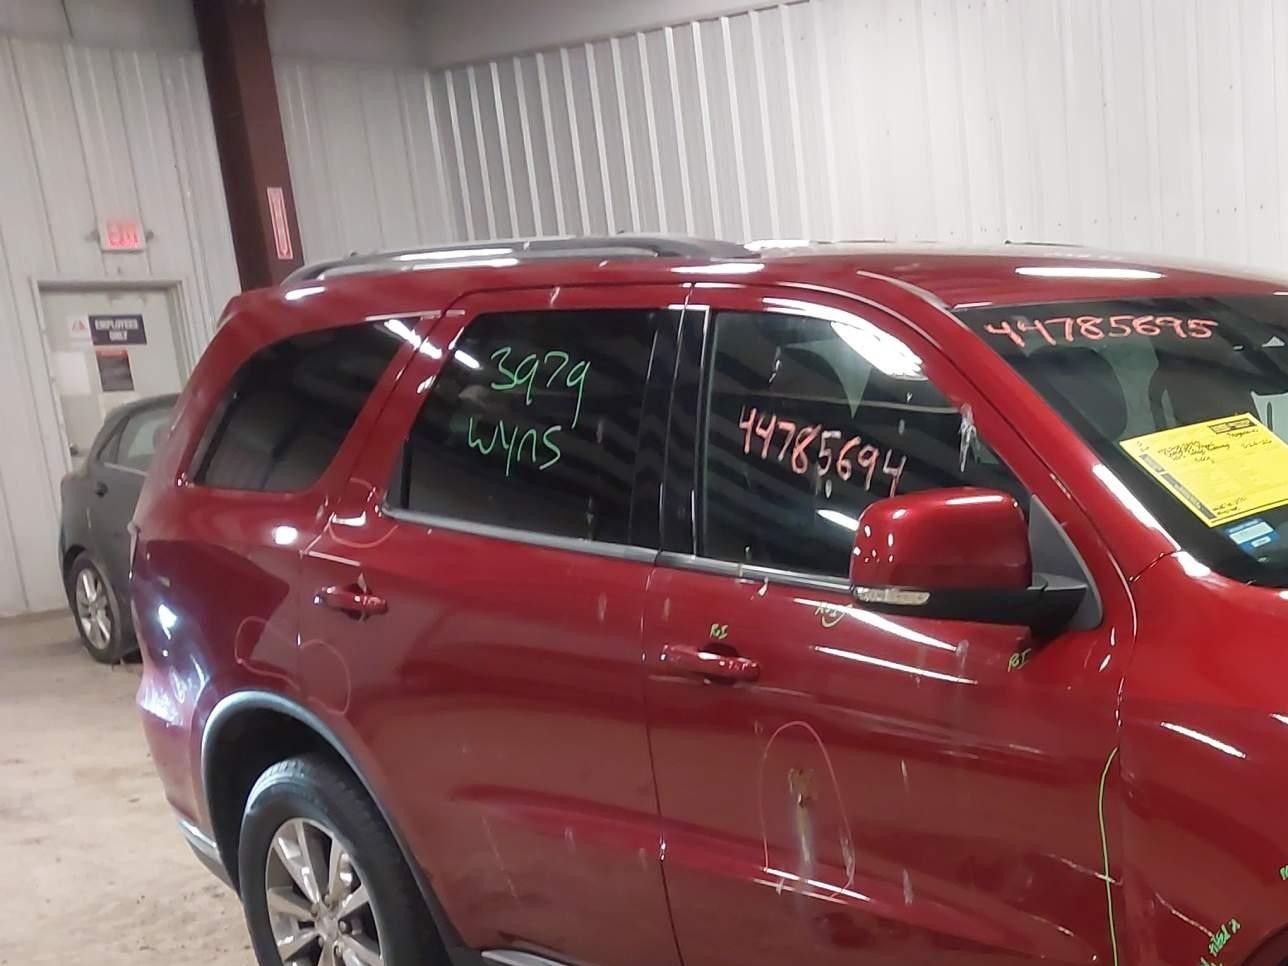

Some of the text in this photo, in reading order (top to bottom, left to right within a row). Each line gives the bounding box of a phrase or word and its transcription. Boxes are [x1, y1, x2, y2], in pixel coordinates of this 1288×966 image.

[985, 315, 1219, 348] 44785695
[490, 347, 591, 429] 3979
[738, 405, 907, 497] 44785694
